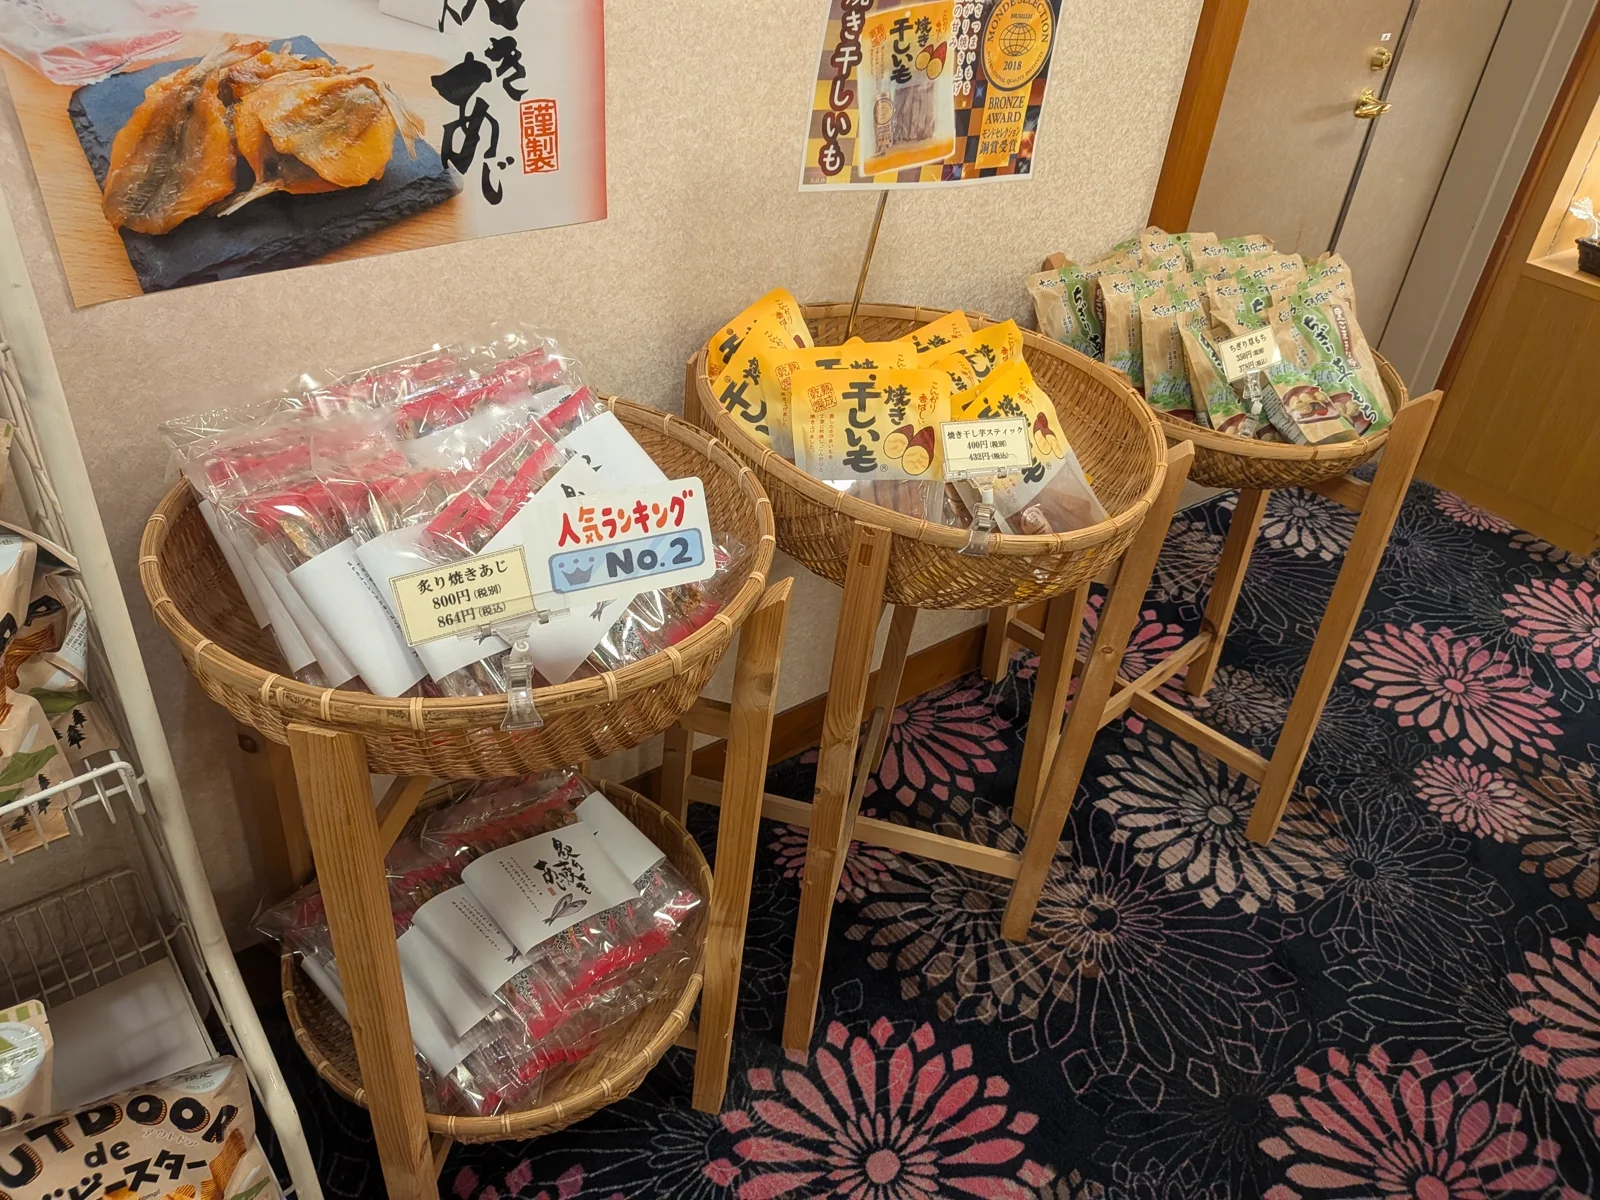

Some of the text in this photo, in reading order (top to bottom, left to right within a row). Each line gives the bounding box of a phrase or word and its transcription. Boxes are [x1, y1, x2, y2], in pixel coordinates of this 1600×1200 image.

[915, 16, 932, 47] 焼き
[987, 0, 1017, 42] MONDE
[889, 18, 914, 84] 干しいも
[953, 0, 974, 95] がり焼き上げ
[964, 0, 984, 94] さつまいもを
[1003, 61, 1022, 70] 2018
[822, 0, 870, 173] き干しいも
[988, 96, 1026, 110] BRONZE
[430, 51, 516, 206] あじ
[982, 126, 1020, 139] モンドセレクション
[985, 111, 1022, 124] AWARD
[521, 100, 557, 173] 謹製
[979, 139, 1018, 155] 銅賞受賞
[1071, 285, 1104, 360] ちぎり草
[883, 383, 912, 426] 焼き
[928, 381, 940, 415] こんがり
[841, 381, 883, 473] 干しいも
[947, 426, 1023, 440] 焼き干し芋スティック
[967, 440, 988, 450] 400円
[968, 452, 990, 462] 432円
[557, 489, 694, 548] 人気ランキング
[417, 560, 508, 595] 炙り焼きあじ
[432, 583, 502, 610] 800円 (税別)
[437, 601, 507, 628] 864円 (税込)
[0, 1094, 239, 1190] UTDOOR
[142, 1126, 200, 1148] アウトドア
[84, 1141, 131, 1169] de
